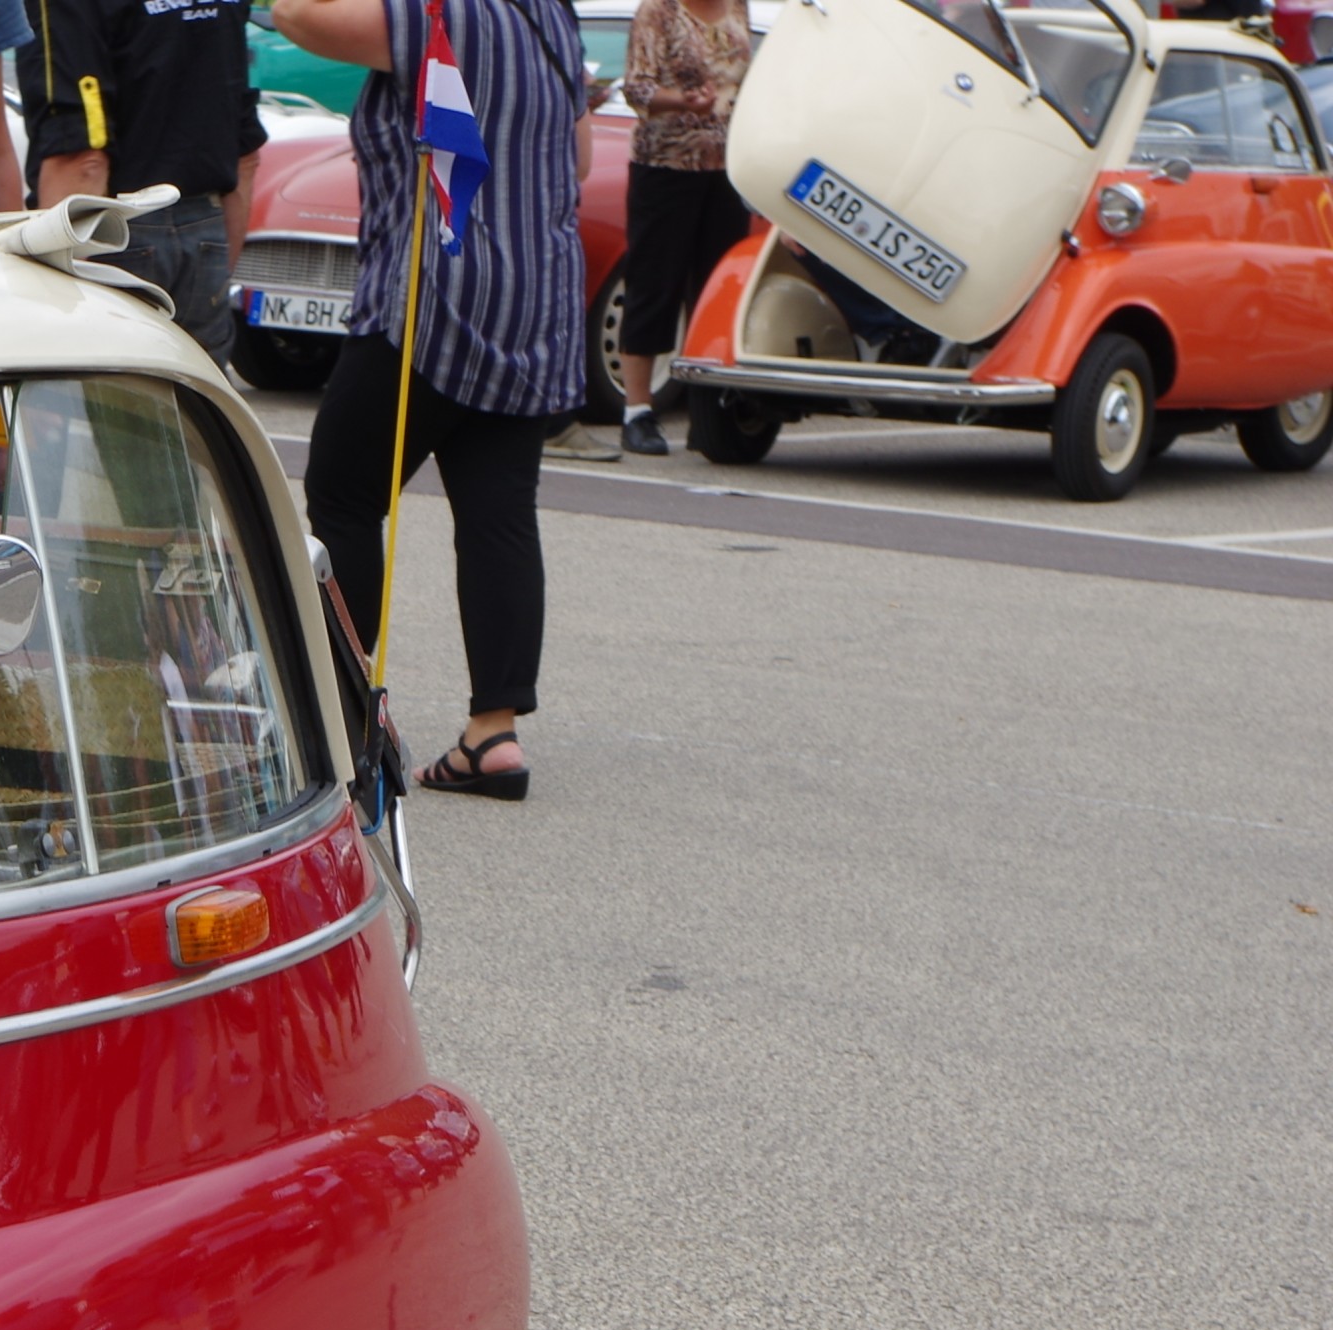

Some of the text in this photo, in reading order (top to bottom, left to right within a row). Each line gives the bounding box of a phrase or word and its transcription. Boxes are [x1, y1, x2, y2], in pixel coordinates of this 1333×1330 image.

[809, 179, 956, 290] SAB IS 250
[263, 297, 292, 323] NK
[306, 300, 334, 327] BH
